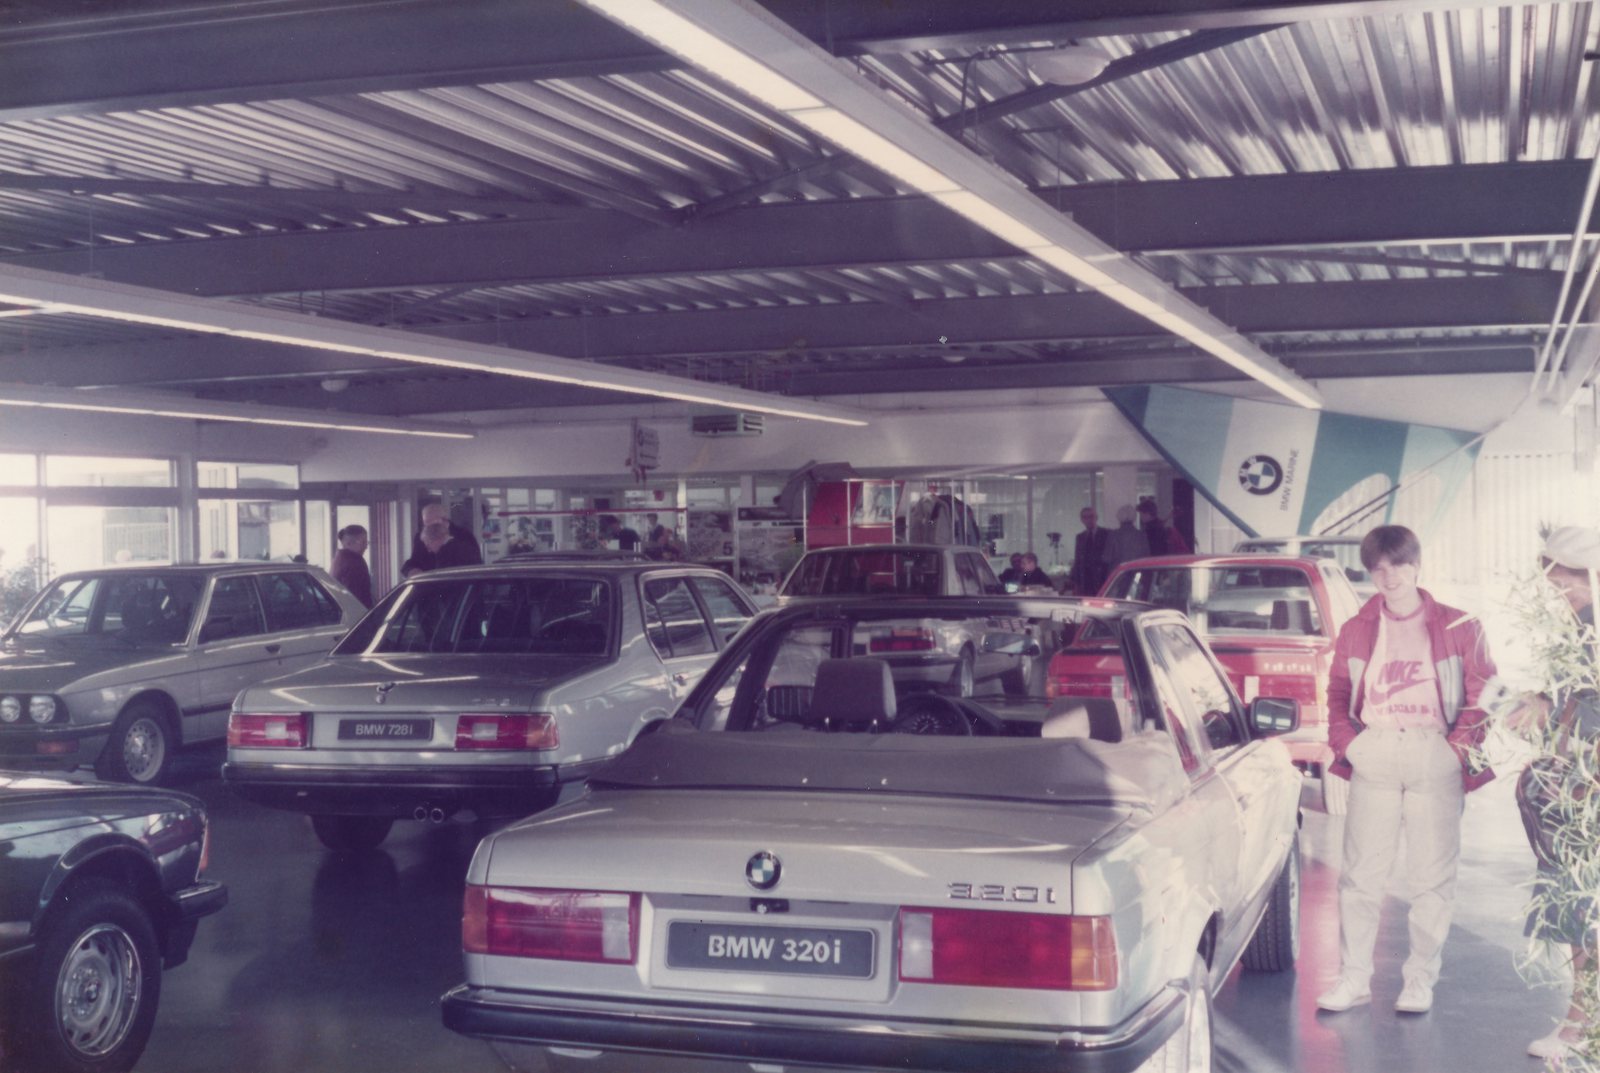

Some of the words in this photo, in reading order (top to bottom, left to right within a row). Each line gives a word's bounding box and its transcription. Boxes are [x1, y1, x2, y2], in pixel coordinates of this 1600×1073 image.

[1280, 487, 1291, 511] BMW
[1286, 448, 1299, 485] MARINE
[1377, 660, 1423, 685] NIKE
[355, 724, 386, 736] BMW
[708, 935, 775, 960] BMW
[781, 939, 841, 964] 320i
